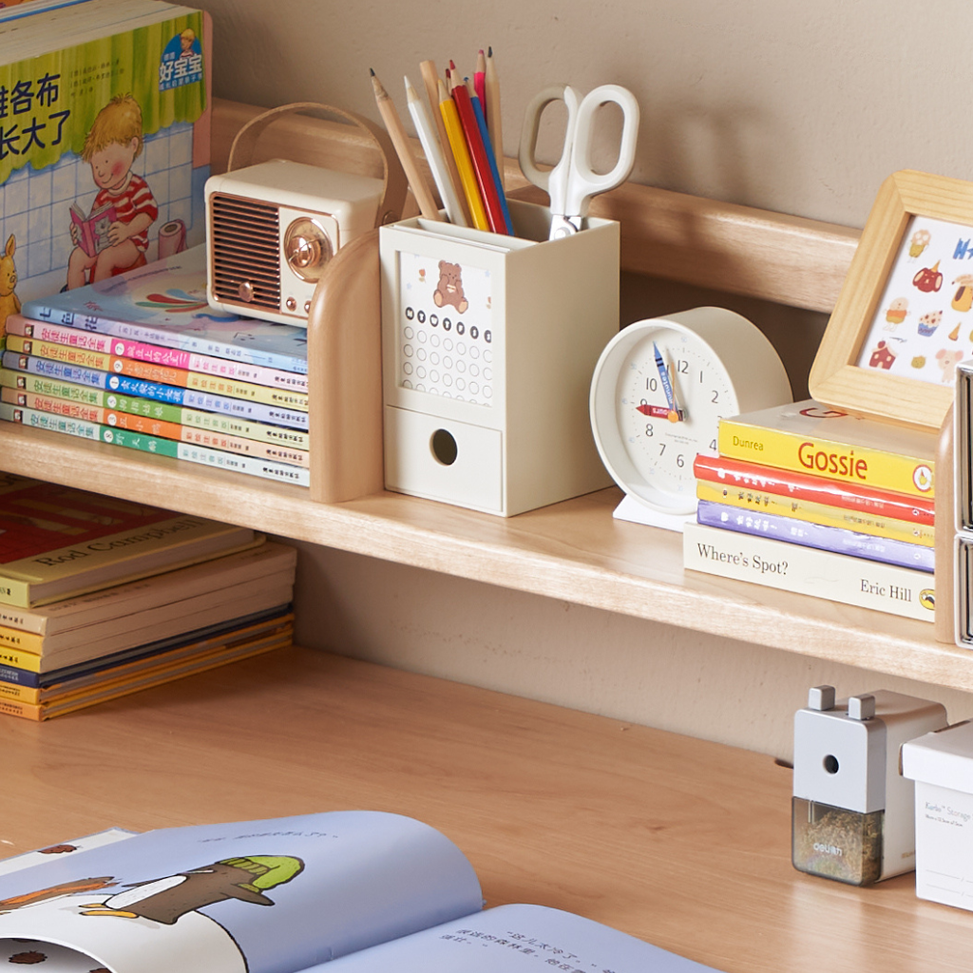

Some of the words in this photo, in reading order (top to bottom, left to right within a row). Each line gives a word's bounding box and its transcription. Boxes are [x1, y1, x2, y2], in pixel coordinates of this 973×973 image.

[159, 54, 203, 83] 好宝宝
[0, 109, 71, 160] 长大了
[39, 308, 98, 331] 七色花
[41, 328, 105, 349] 安徒生童话全集
[40, 344, 103, 367] 安徒生童话全集
[678, 360, 689, 374] 12
[35, 360, 100, 385] 安徒生童话全集
[33, 379, 97, 404] 安徒生童话全集
[645, 377, 658, 392] 10
[711, 390, 719, 404] 2
[34, 397, 98, 422] 安徒生童话全集
[30, 412, 94, 437] 安徒生童话全集
[645, 424, 654, 437] 8
[658, 443, 666, 456] 7
[709, 439, 717, 451] 4
[732, 435, 764, 451] Dunrea
[676, 454, 684, 468] 6
[798, 442, 868, 480] Gossie
[33, 549, 88, 567] Rod
[697, 542, 749, 568] Where's
[752, 555, 789, 576] Spot?
[860, 579, 886, 597] Eric
[889, 586, 912, 602] Hill
